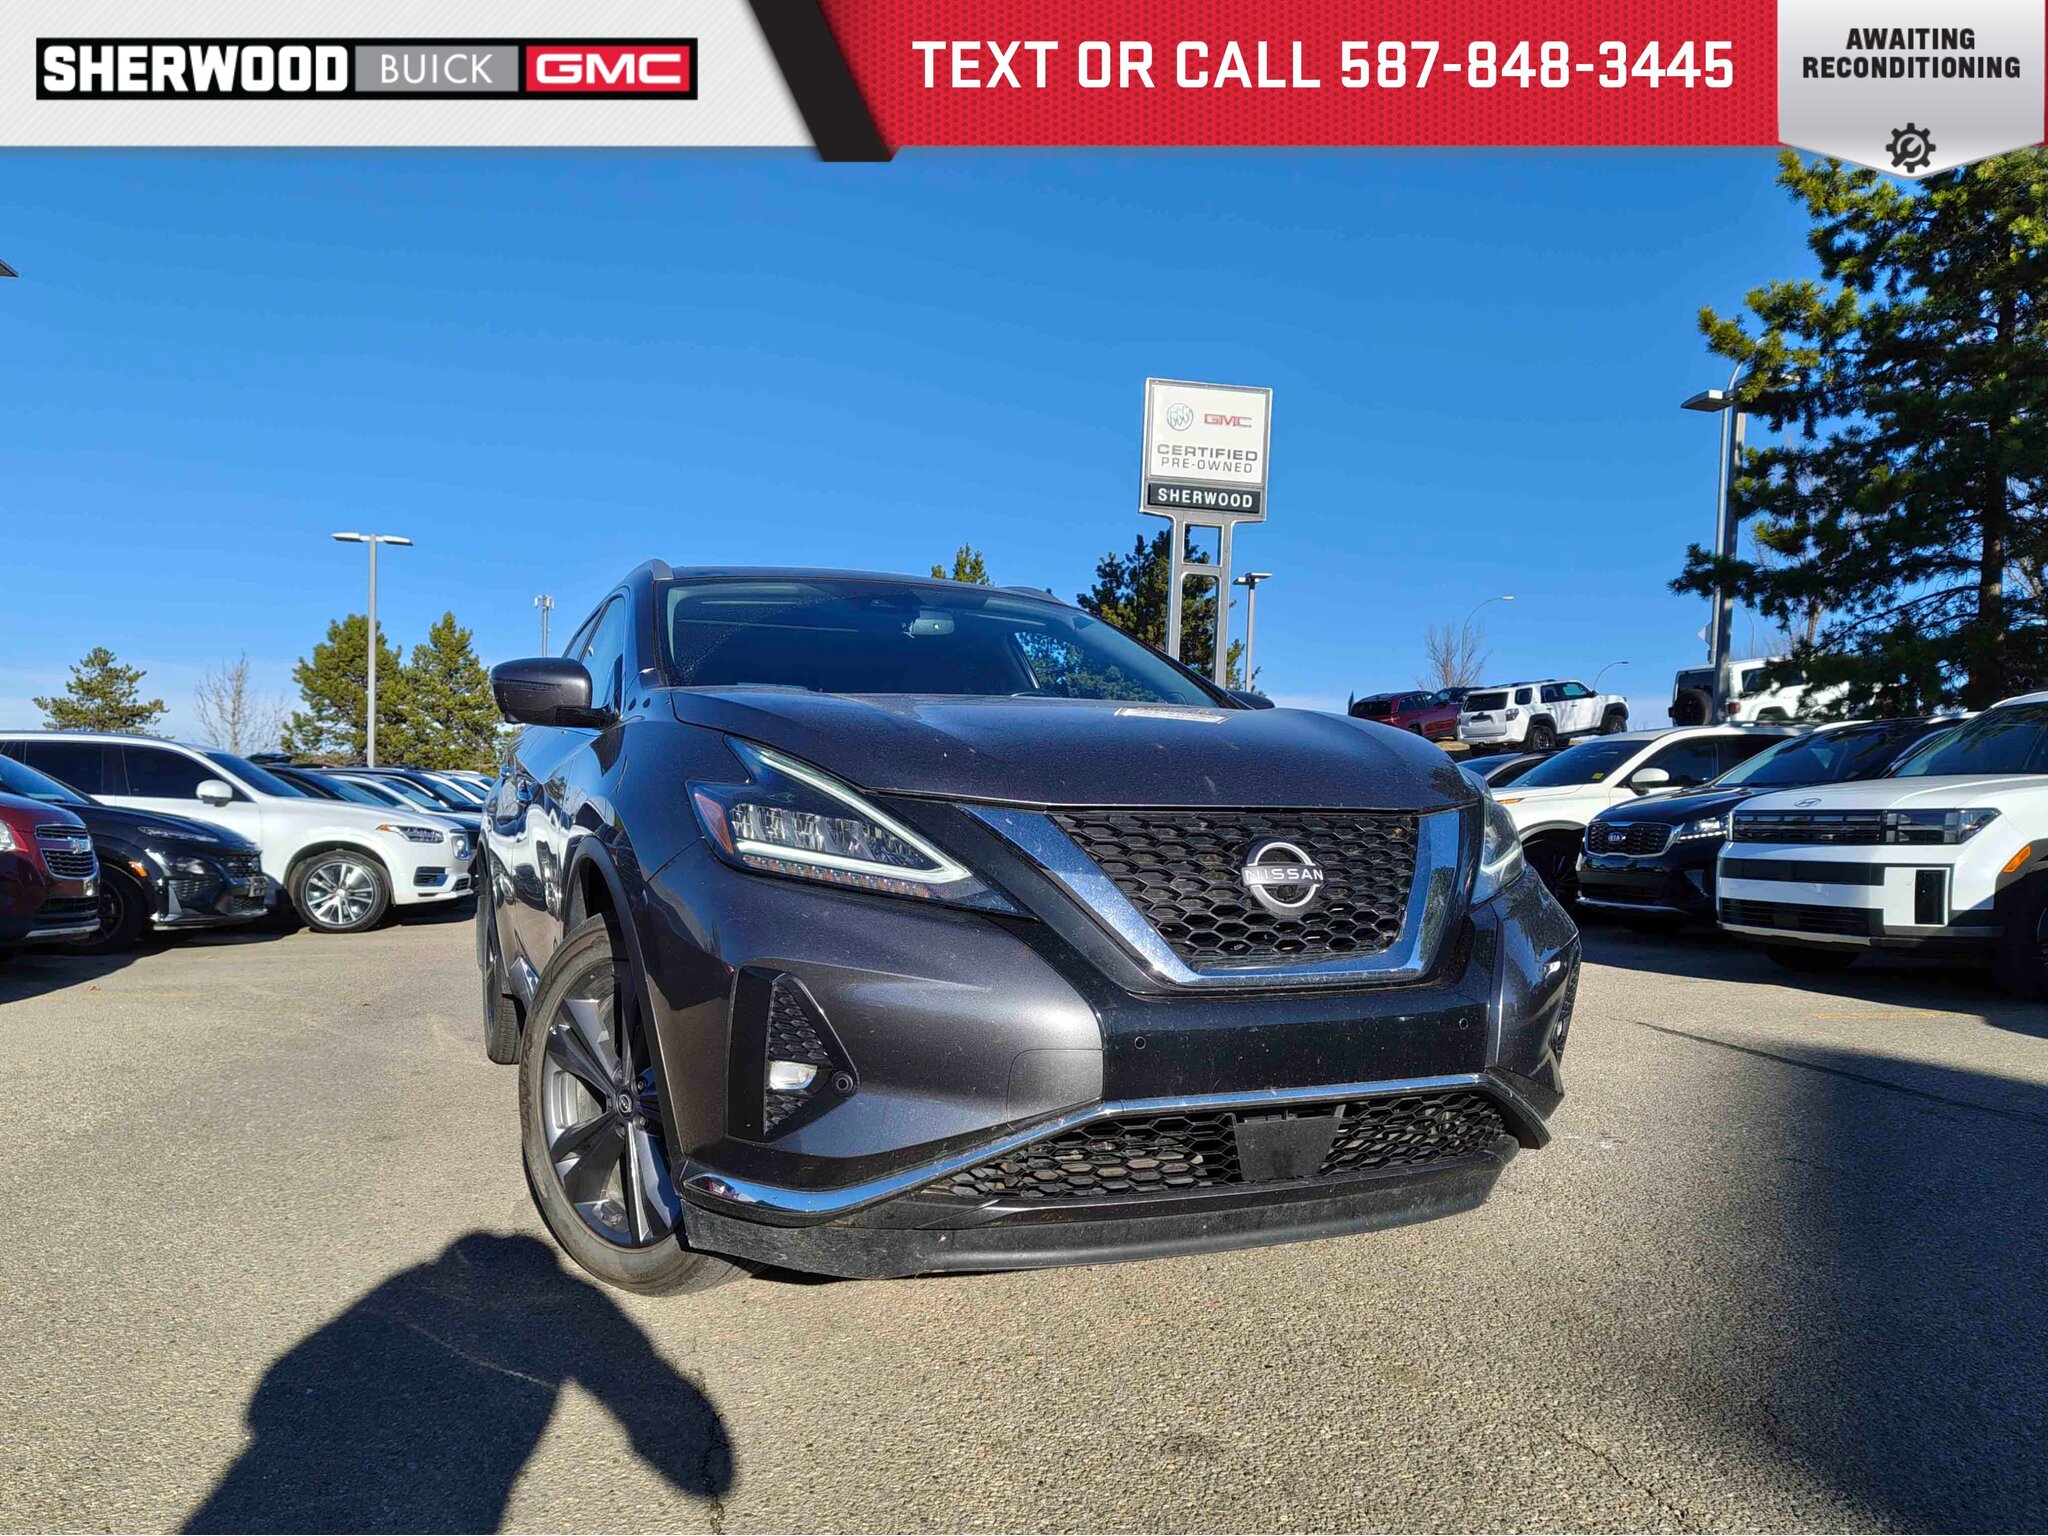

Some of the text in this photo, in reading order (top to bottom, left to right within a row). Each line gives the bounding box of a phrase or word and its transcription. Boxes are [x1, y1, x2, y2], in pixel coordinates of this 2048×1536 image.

[1203, 413, 1253, 428] GMC
[1157, 443, 1258, 461] CERTIFIED
[1161, 457, 1252, 473] PRE-OWNED
[1158, 487, 1253, 508] SHERWOOD
[1245, 868, 1324, 881] NISSAN
